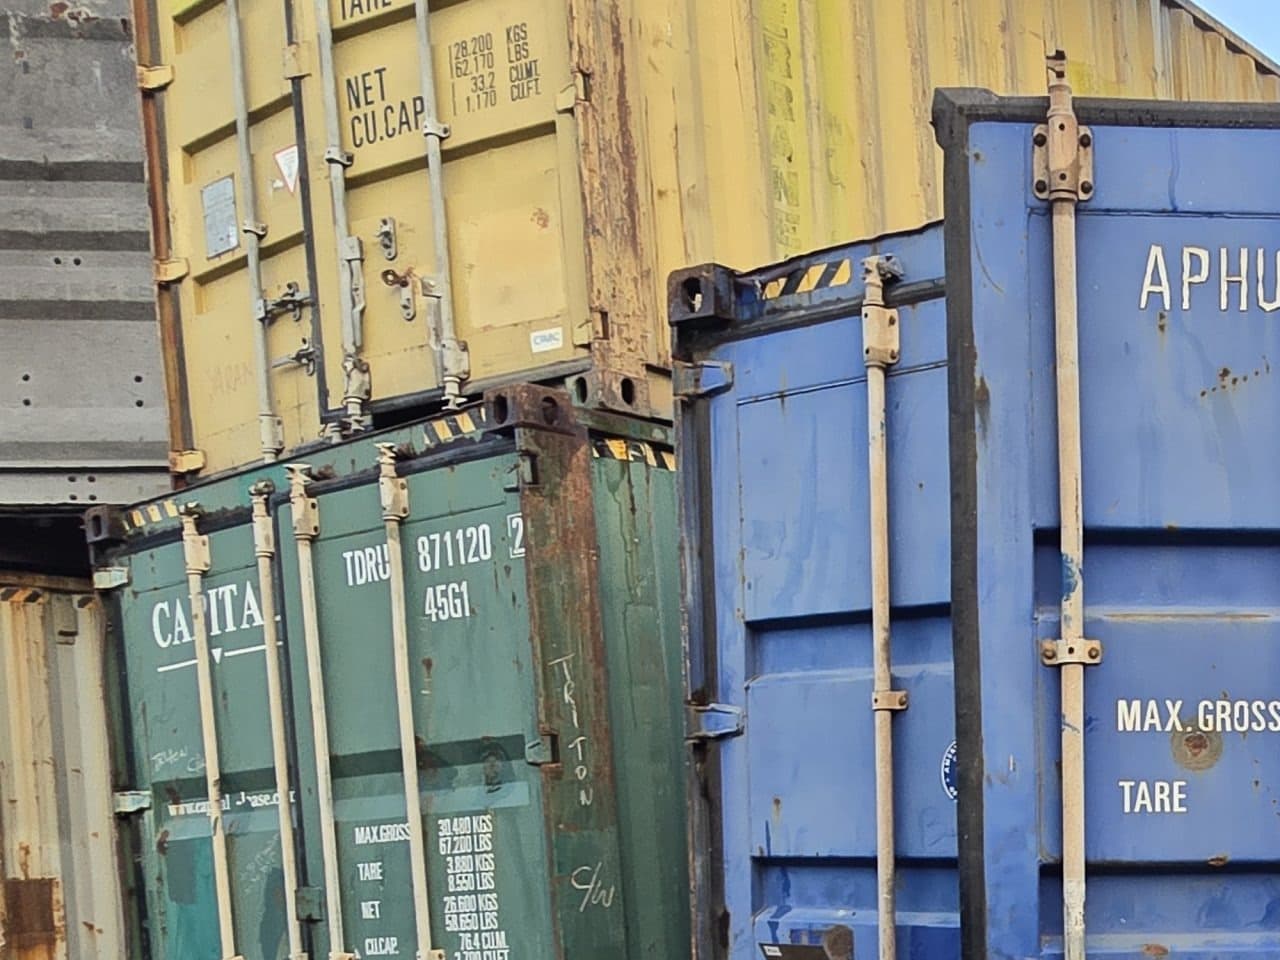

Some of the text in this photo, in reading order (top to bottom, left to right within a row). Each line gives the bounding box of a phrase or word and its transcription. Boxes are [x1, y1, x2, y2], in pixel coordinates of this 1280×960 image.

[345, 22, 528, 111] NET 28.200 KGS
[454, 41, 529, 78] 62.170 LBS
[470, 71, 496, 93] 33.2
[465, 89, 497, 113] 1.170
[342, 517, 526, 586] TDRU 871120 2
[152, 580, 282, 648] CAITA
[424, 580, 471, 622] 45G1
[1118, 780, 1188, 814] TARE
[472, 814, 493, 833] KGS
[473, 833, 493, 852] LBS
[357, 861, 384, 881] TARE
[474, 852, 495, 872] KGS
[475, 871, 495, 890] LBS
[360, 900, 381, 919] NET
[477, 892, 499, 912] KGS
[479, 911, 499, 930] LBS
[458, 932, 481, 951] 76.4
